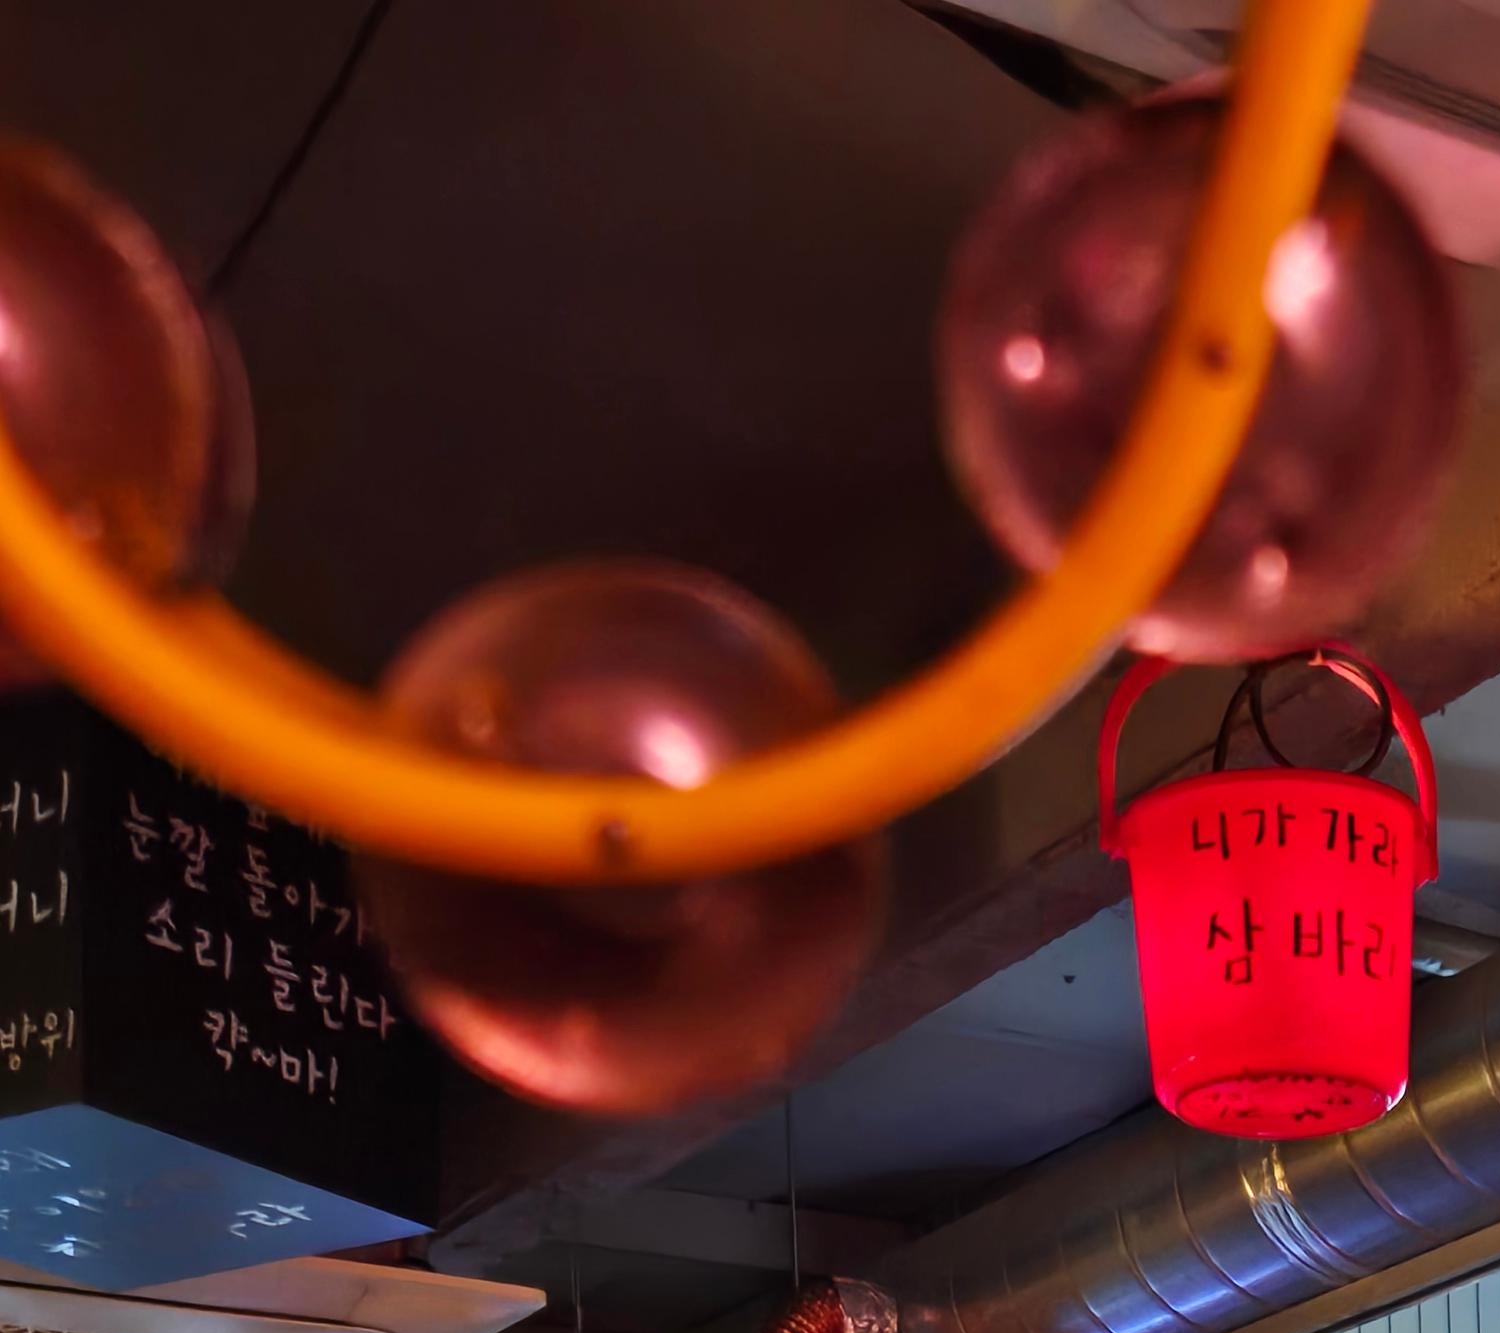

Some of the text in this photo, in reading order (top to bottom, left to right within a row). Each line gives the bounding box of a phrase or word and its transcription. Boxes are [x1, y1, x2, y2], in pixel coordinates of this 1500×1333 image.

[1191, 803, 1399, 877] 니가 가라
[145, 898, 396, 1040] 소리 들린다
